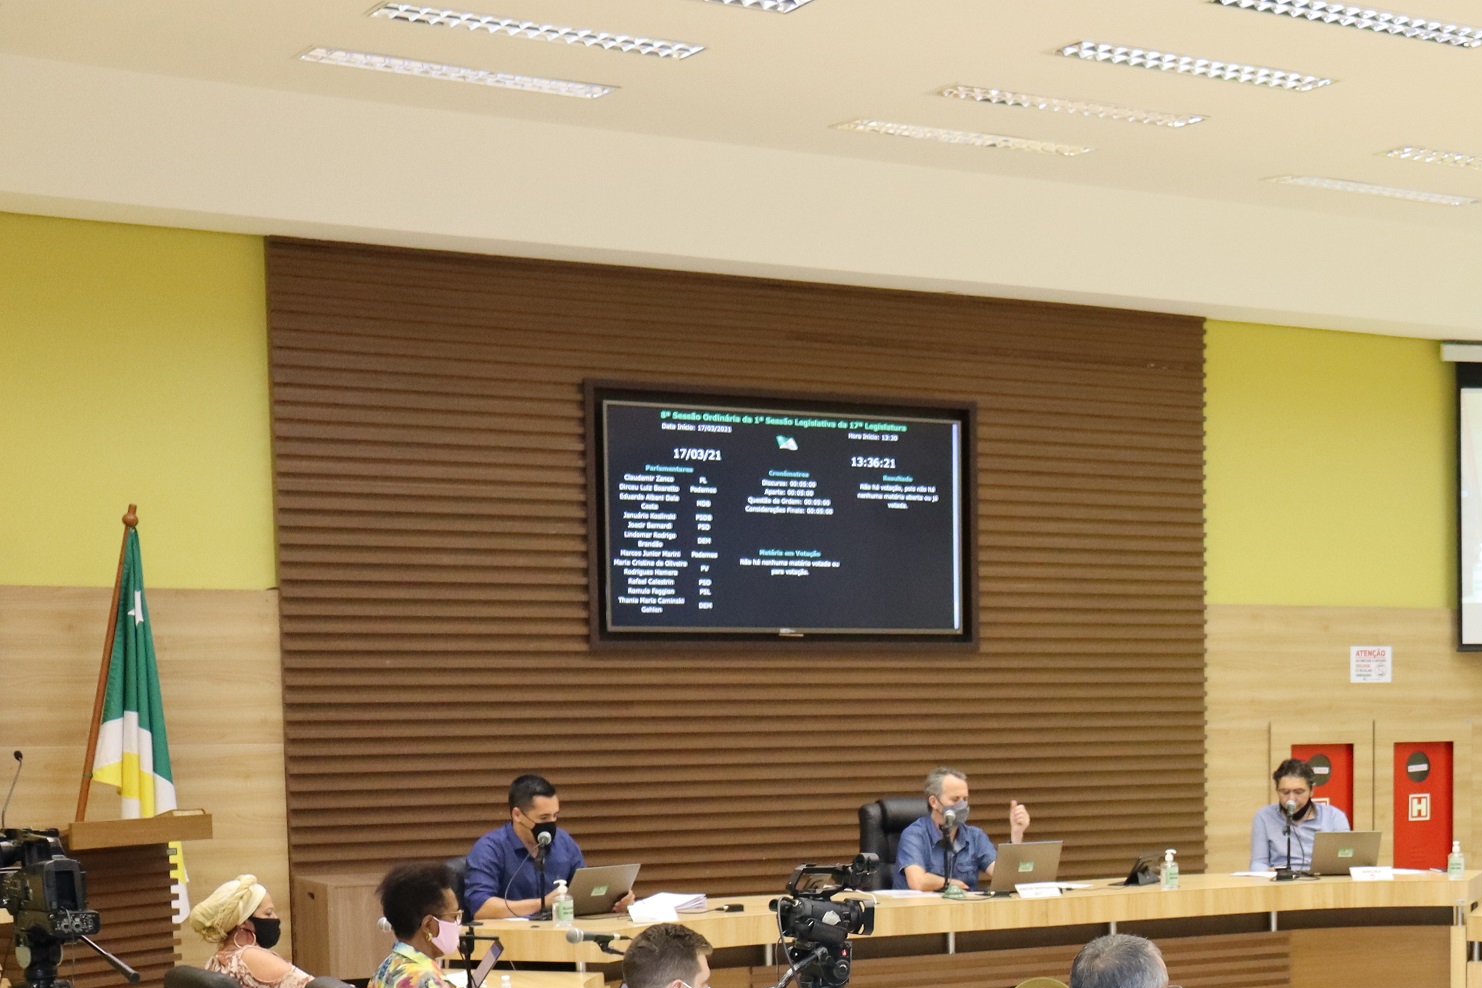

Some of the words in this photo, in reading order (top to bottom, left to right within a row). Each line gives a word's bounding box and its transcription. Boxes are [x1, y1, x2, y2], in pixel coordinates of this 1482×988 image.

[661, 422, 676, 431] Data
[672, 411, 700, 421] Sessão
[702, 413, 740, 423] Ordinária
[741, 415, 753, 424] da
[765, 417, 793, 426] Sessão
[794, 418, 836, 429] Legislativa
[838, 420, 848, 429] da
[864, 423, 907, 432] Legislatura
[848, 432, 862, 440] Hora
[673, 448, 722, 461] 17/03/21
[851, 456, 896, 469] 13:36:21
[1355, 648, 1386, 658] ATENÇÃO
[1411, 798, 1427, 817] H
